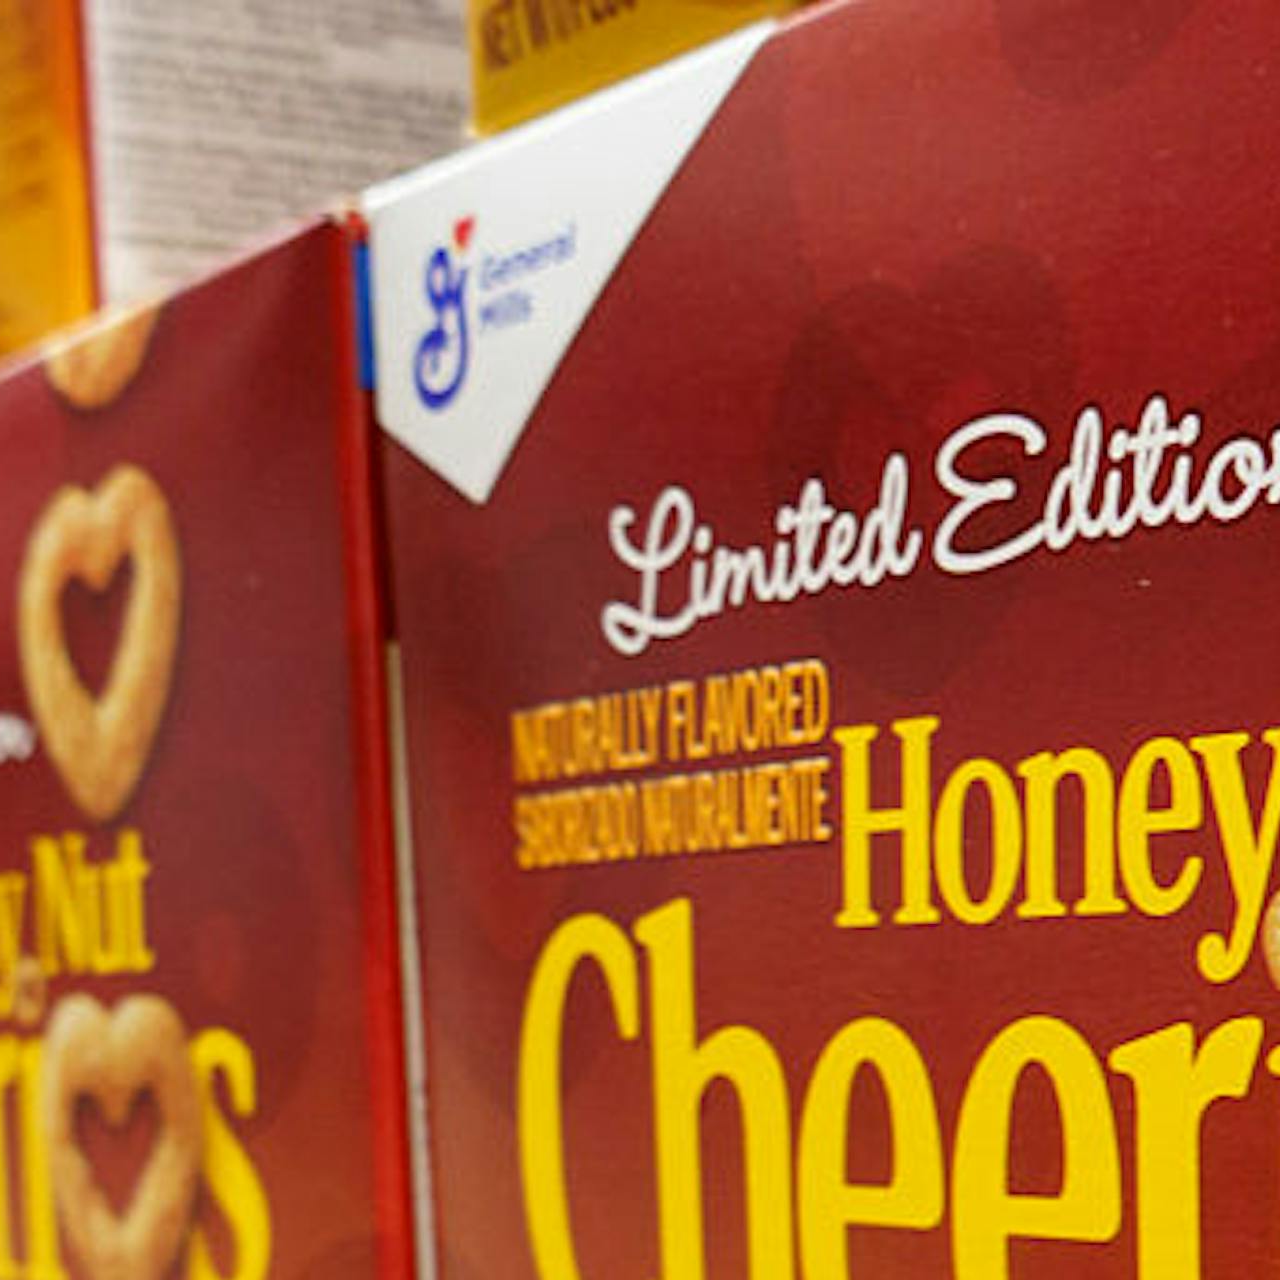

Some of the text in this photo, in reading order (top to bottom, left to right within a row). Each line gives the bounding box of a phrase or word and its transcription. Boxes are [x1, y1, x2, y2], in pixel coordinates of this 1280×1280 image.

[601, 452, 922, 655] Limited
[511, 657, 830, 784] NATURALLY FLAVORED
